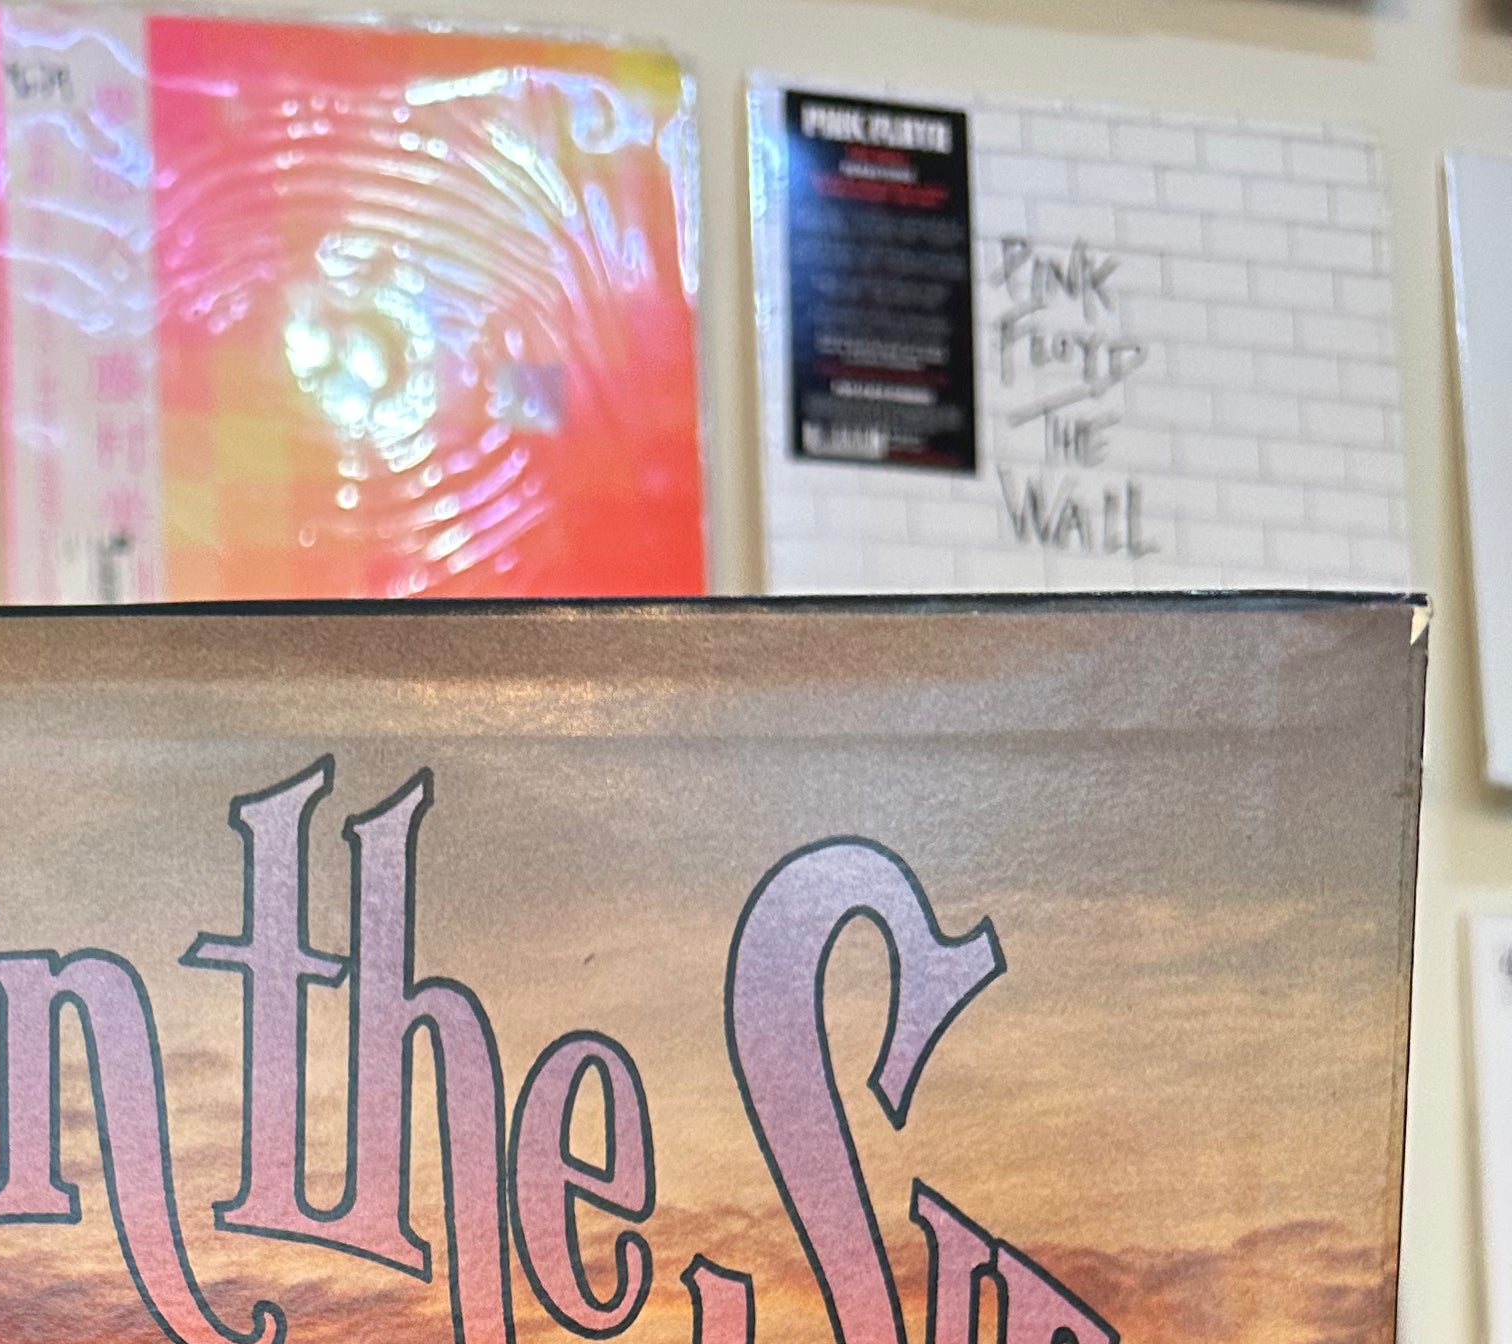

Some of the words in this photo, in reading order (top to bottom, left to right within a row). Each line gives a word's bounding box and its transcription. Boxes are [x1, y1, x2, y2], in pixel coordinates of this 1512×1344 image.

[989, 236, 1122, 325] PINK
[993, 303, 1150, 390] FLOYD
[1006, 385, 1122, 468] THE
[995, 464, 1162, 561] WALL
